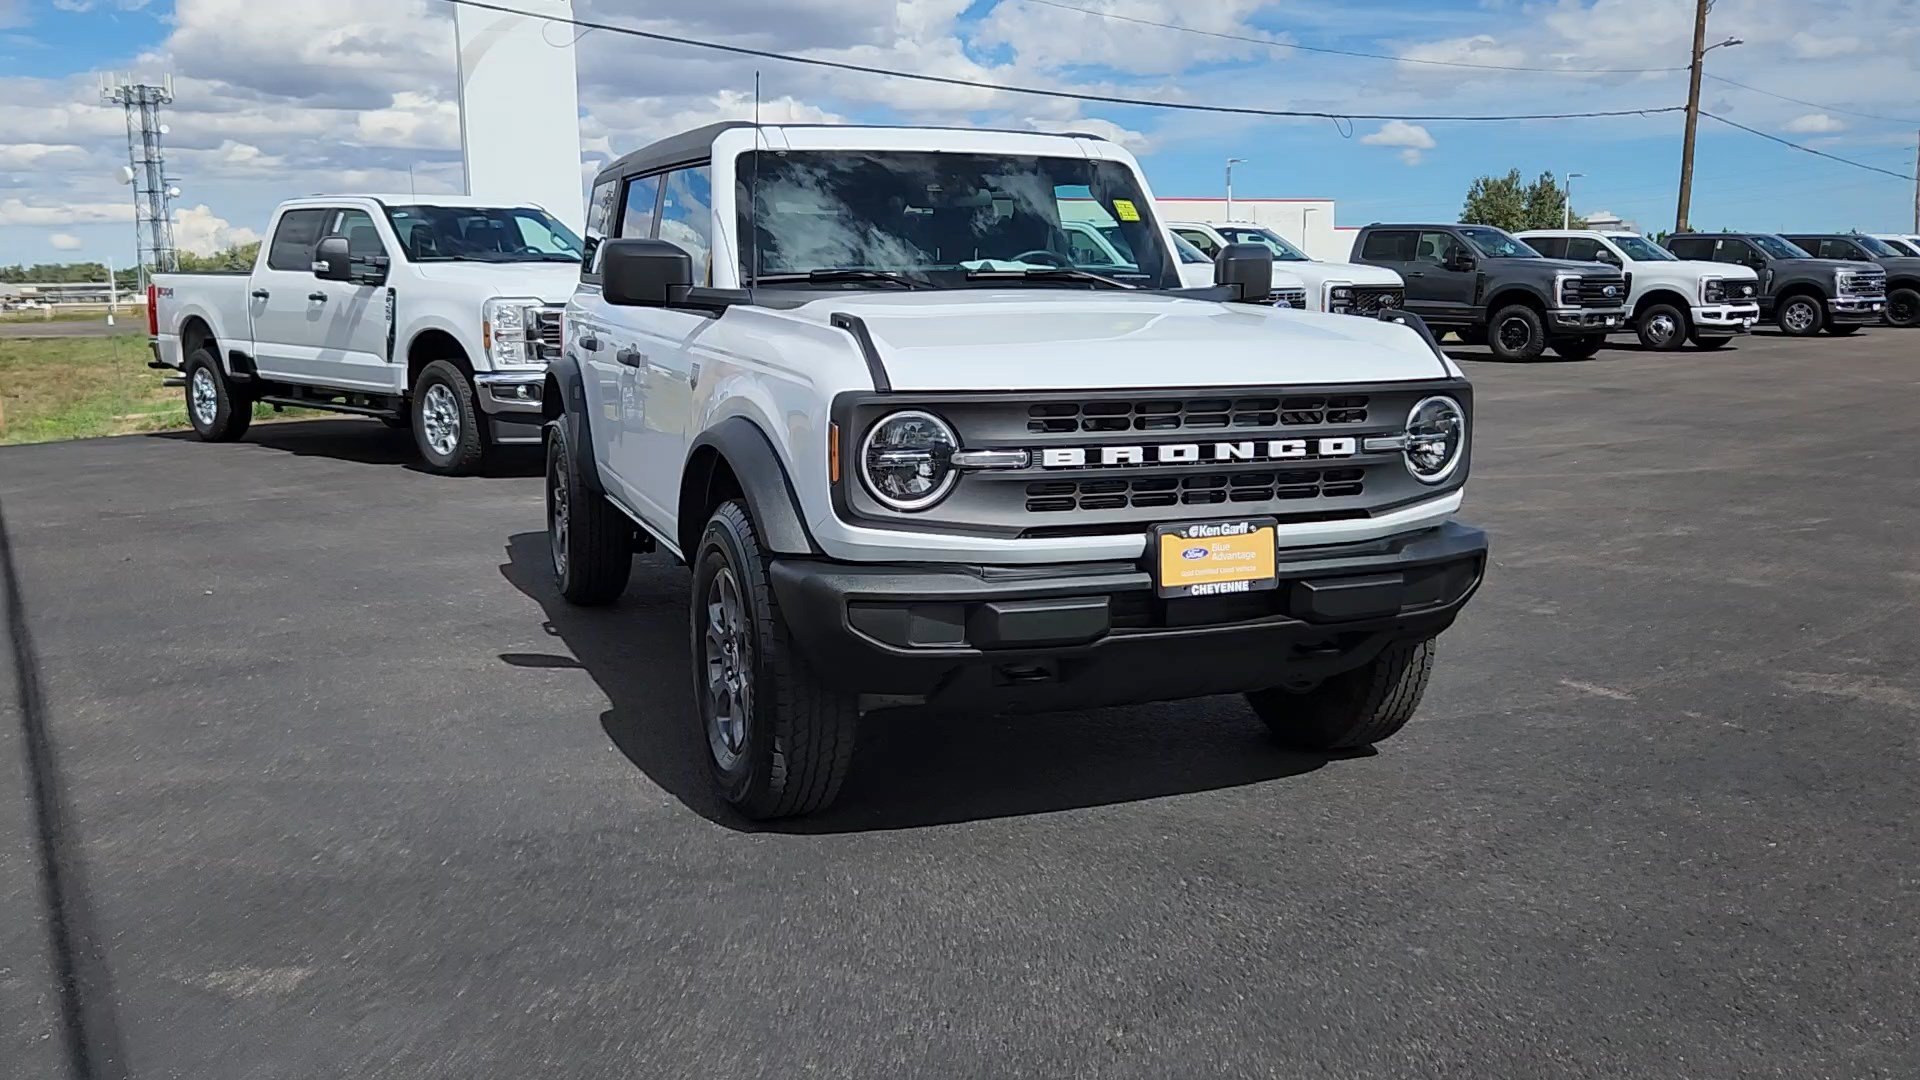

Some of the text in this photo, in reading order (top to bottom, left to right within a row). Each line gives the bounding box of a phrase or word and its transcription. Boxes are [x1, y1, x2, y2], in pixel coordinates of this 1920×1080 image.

[1042, 437, 1356, 467] BRONCO
[1200, 522, 1248, 537] Ken Garff
[1212, 543, 1230, 552] Blue
[1183, 549, 1207, 559] Ford
[1212, 551, 1256, 561] Advantage
[1191, 581, 1249, 595] CHEYENNE
